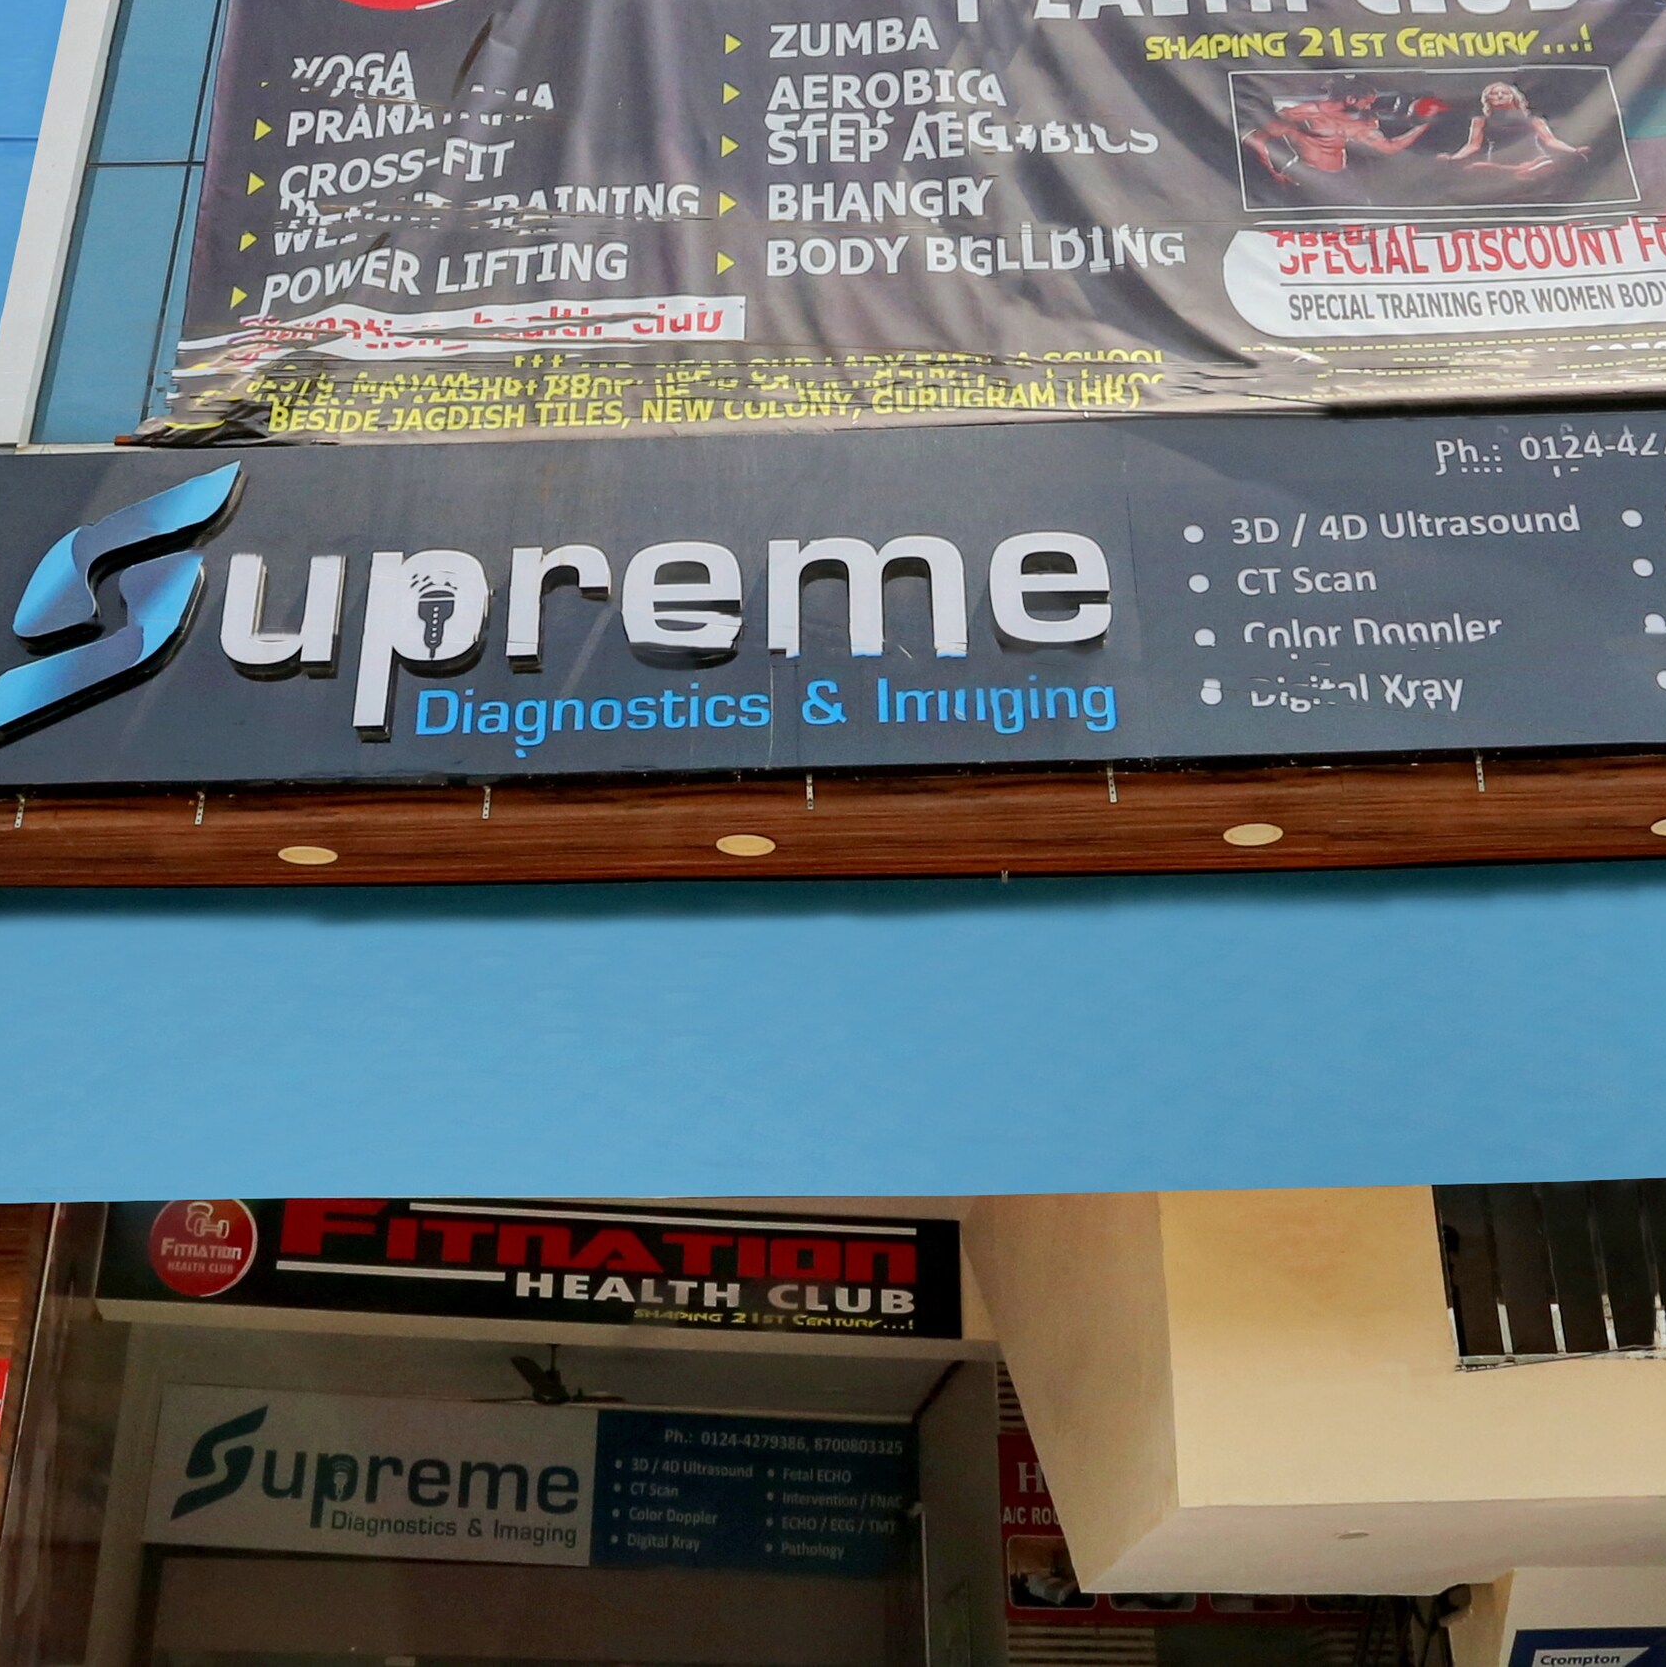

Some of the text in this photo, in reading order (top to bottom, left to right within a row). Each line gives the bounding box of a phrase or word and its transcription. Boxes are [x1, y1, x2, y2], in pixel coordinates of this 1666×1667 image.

[767, 16, 940, 59] ZUMBA
[1144, 33, 1287, 62] SHAPING
[278, 138, 515, 200] CROSS-FIT
[766, 234, 910, 278] BODY
[260, 241, 629, 318] POWER LIFTING
[1288, 292, 1375, 322] SPECIAL
[1376, 290, 1482, 320] TRAINING
[1487, 287, 1530, 316] FOR
[1532, 283, 1615, 314] WOMEN
[267, 403, 390, 433] BESIDE
[388, 403, 526, 432] JAGDISH
[641, 398, 714, 424] NEW
[1230, 503, 1581, 546] 3D 4D Ultrasound
[1236, 565, 1378, 596] CT Scan
[414, 681, 771, 748] Diagnostics
[800, 679, 848, 725] &
[166, 1260, 236, 1275] HEALTH CLUB
[514, 1271, 917, 1315] HEALTH CLUB
[633, 1307, 724, 1324] SHAPING
[169, 1403, 581, 1530] Supreme
[630, 1457, 754, 1478] 3D 4D Ultrasound
[782, 1468, 852, 1484] Fetal ECHO
[629, 1482, 679, 1498] CT Scan
[782, 1493, 858, 1508] Intervention
[331, 1510, 579, 1549] Diagnostics & Imaging
[628, 1506, 719, 1527] Color Doppler
[781, 1516, 817, 1531] ECHO
[1002, 1506, 1027, 1525] A/C
[626, 1534, 701, 1553] Digital Xray
[780, 1541, 846, 1561] Pathology
